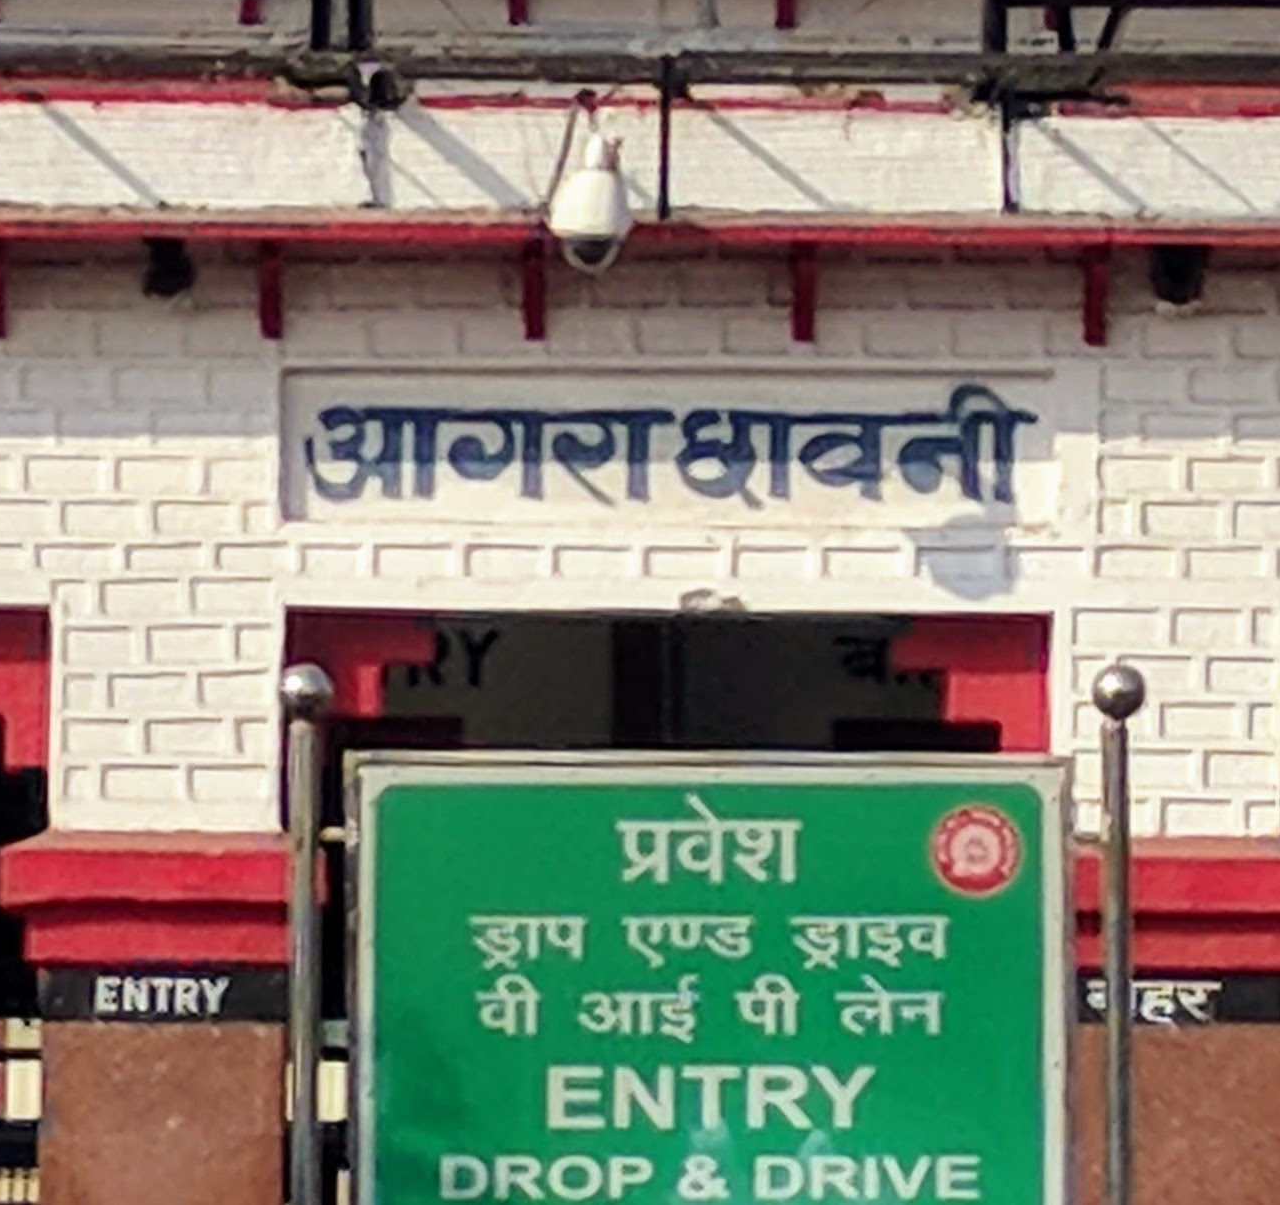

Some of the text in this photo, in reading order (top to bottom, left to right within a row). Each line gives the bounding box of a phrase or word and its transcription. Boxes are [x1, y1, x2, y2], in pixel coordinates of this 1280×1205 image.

[306, 405, 675, 508] आगरा
[615, 792, 803, 885] प्रवेश
[468, 914, 951, 971] ड्राप एण्ड ड्राइव
[94, 974, 231, 1015] ENTRY
[475, 973, 946, 1045] वी आई पी लेन
[546, 1064, 876, 1131] ENTRY
[438, 1154, 983, 1201] DROP & DRIVE
